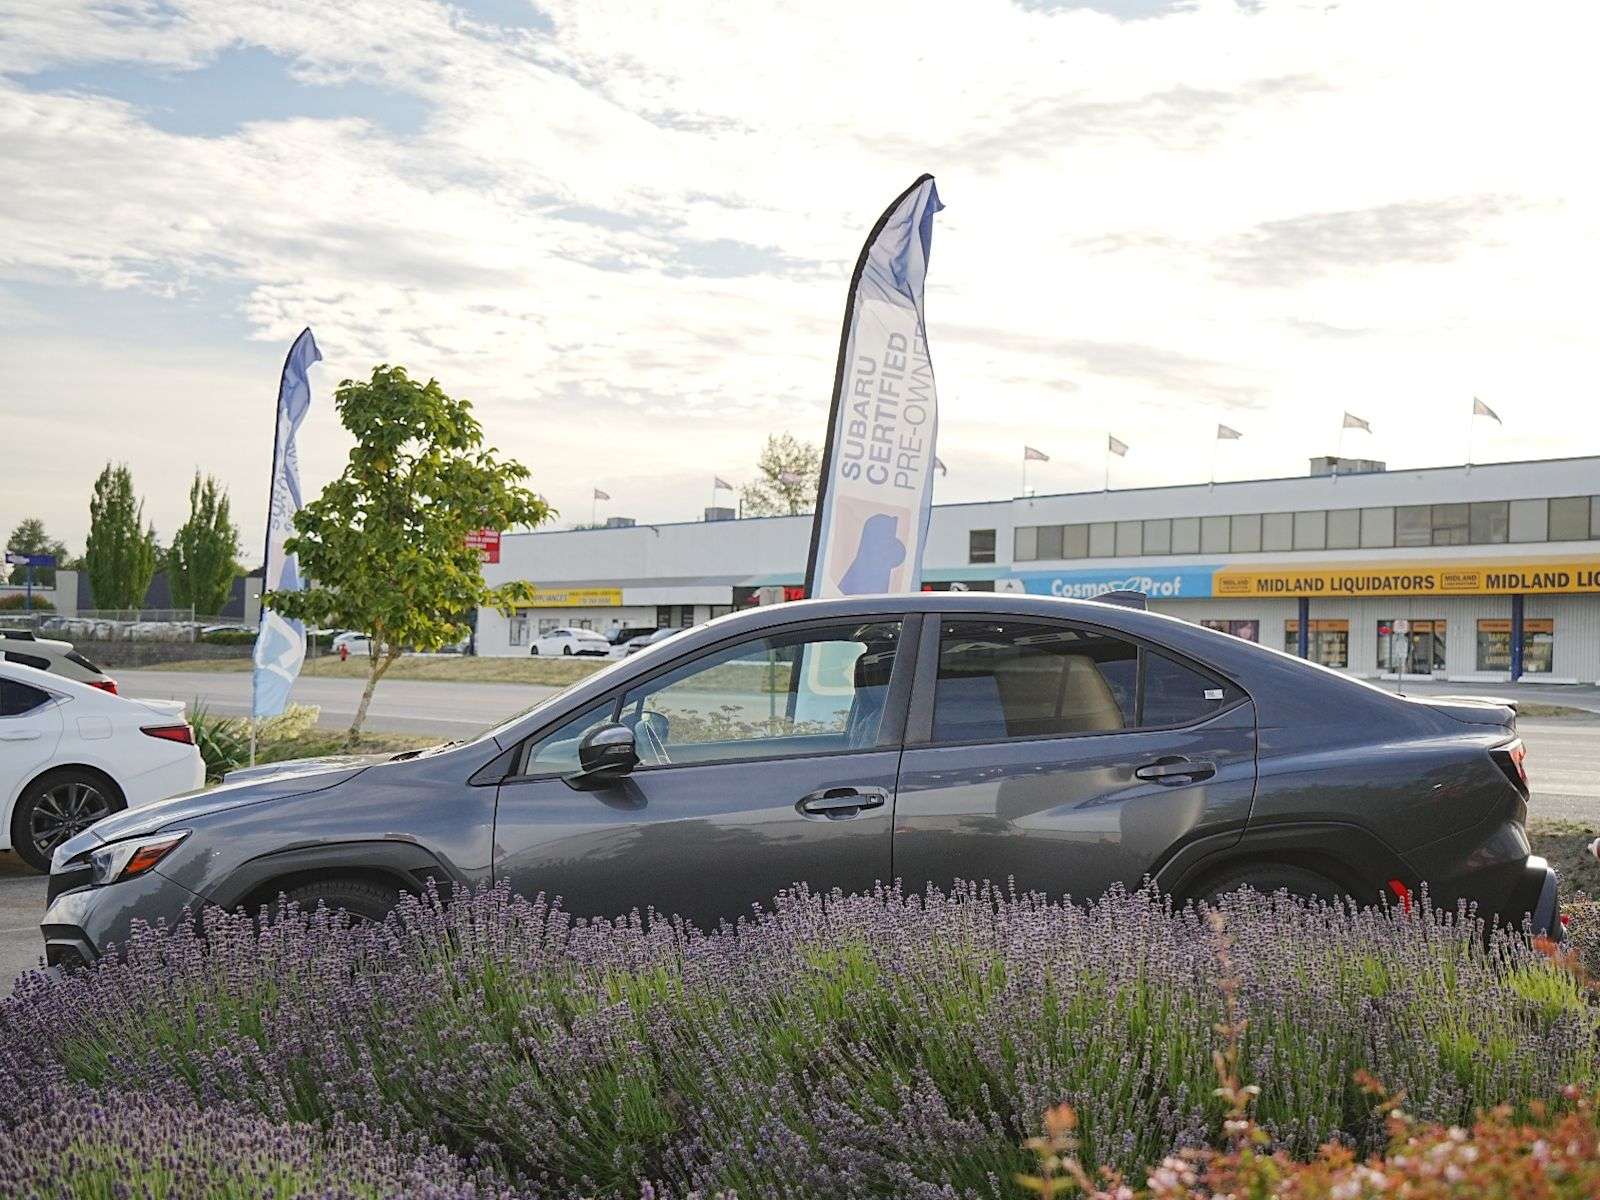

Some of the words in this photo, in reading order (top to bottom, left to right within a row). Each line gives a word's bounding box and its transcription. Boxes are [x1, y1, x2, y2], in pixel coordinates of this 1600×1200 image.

[842, 356, 877, 480] SUBARU
[866, 331, 908, 486] CERTIFIED
[1256, 577, 1325, 593] MIDLAND
[1329, 575, 1435, 592] LIQUIDATORS
[1485, 573, 1570, 589] MIDLAND
